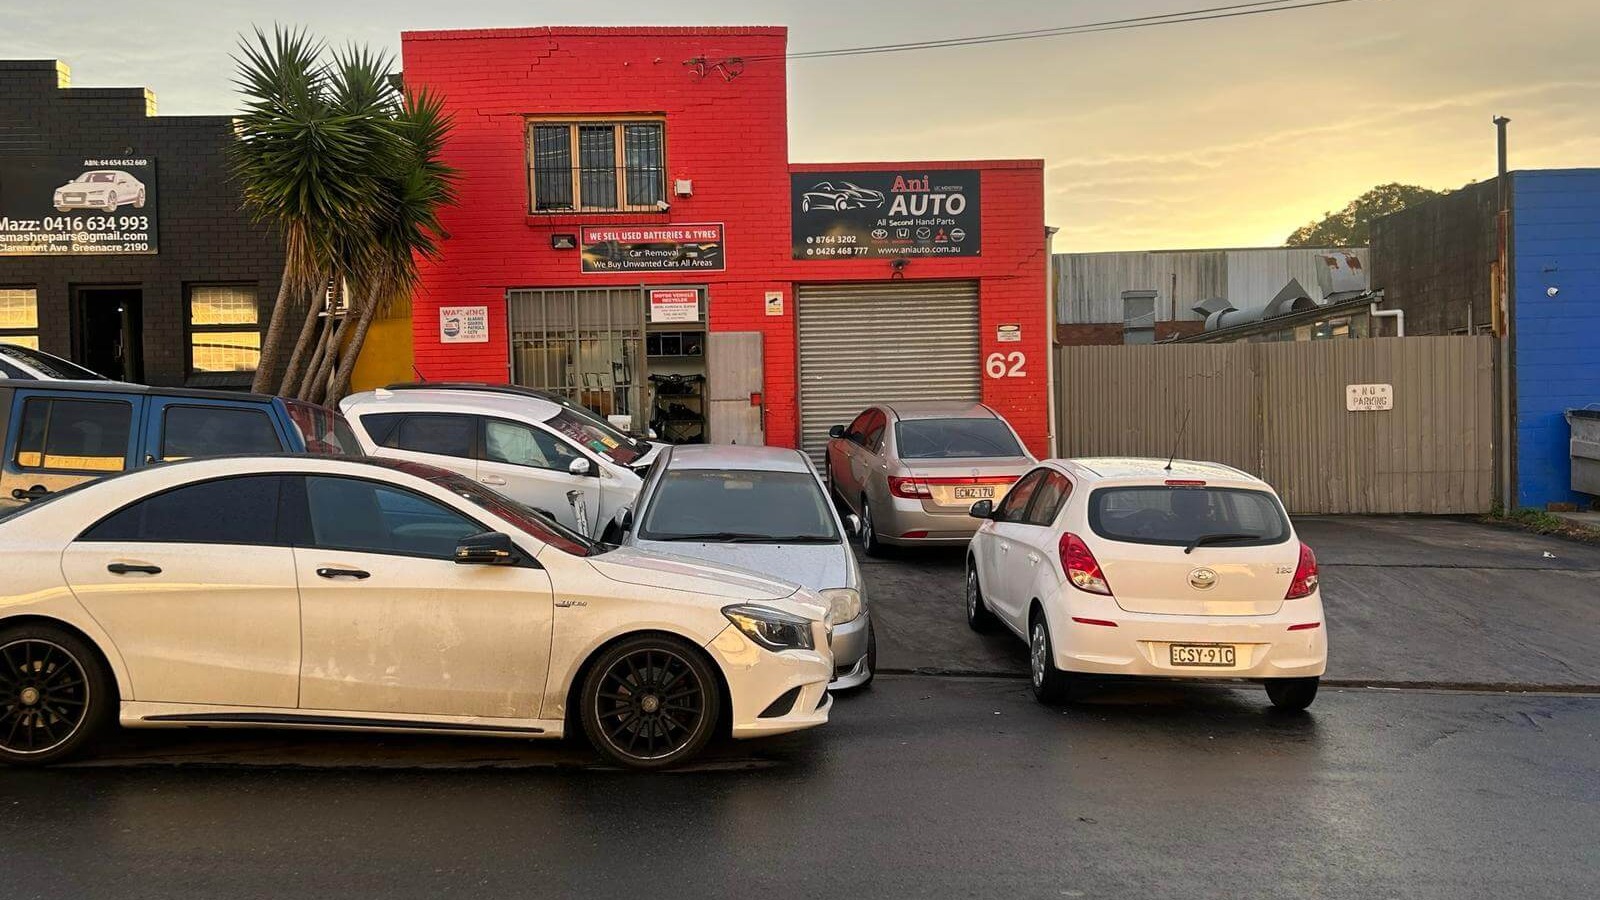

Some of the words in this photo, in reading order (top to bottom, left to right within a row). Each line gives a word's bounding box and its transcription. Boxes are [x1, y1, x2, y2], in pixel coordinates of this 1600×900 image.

[890, 175, 931, 192] Ani
[888, 193, 966, 216] AUTO
[0, 217, 41, 231] Mazz:
[44, 217, 83, 231] 0416
[86, 217, 116, 231] 634
[119, 216, 149, 230] 993
[0, 232, 148, 243] smashrepairs@gmail.com
[590, 232, 602, 241] WE
[603, 232, 621, 240] SELL
[621, 232, 642, 240] USED
[643, 231, 683, 240] BATTERIES
[685, 230, 692, 239] &
[693, 230, 717, 239] TYRES
[815, 236, 835, 244] 8764
[49, 244, 68, 252] Ave
[72, 244, 123, 252] Greenacre
[124, 243, 149, 251] 2190
[815, 247, 836, 255] 0426
[837, 247, 852, 255] 468
[853, 246, 869, 254] 777
[877, 246, 961, 254] www.aniauto.com.au
[608, 261, 622, 270] Buy
[623, 260, 662, 268] Unwanted
[680, 259, 690, 267] All
[691, 259, 713, 267] Areas
[986, 351, 1027, 379] 62
[1361, 386, 1376, 395] NO
[1353, 397, 1387, 406] PARKING
